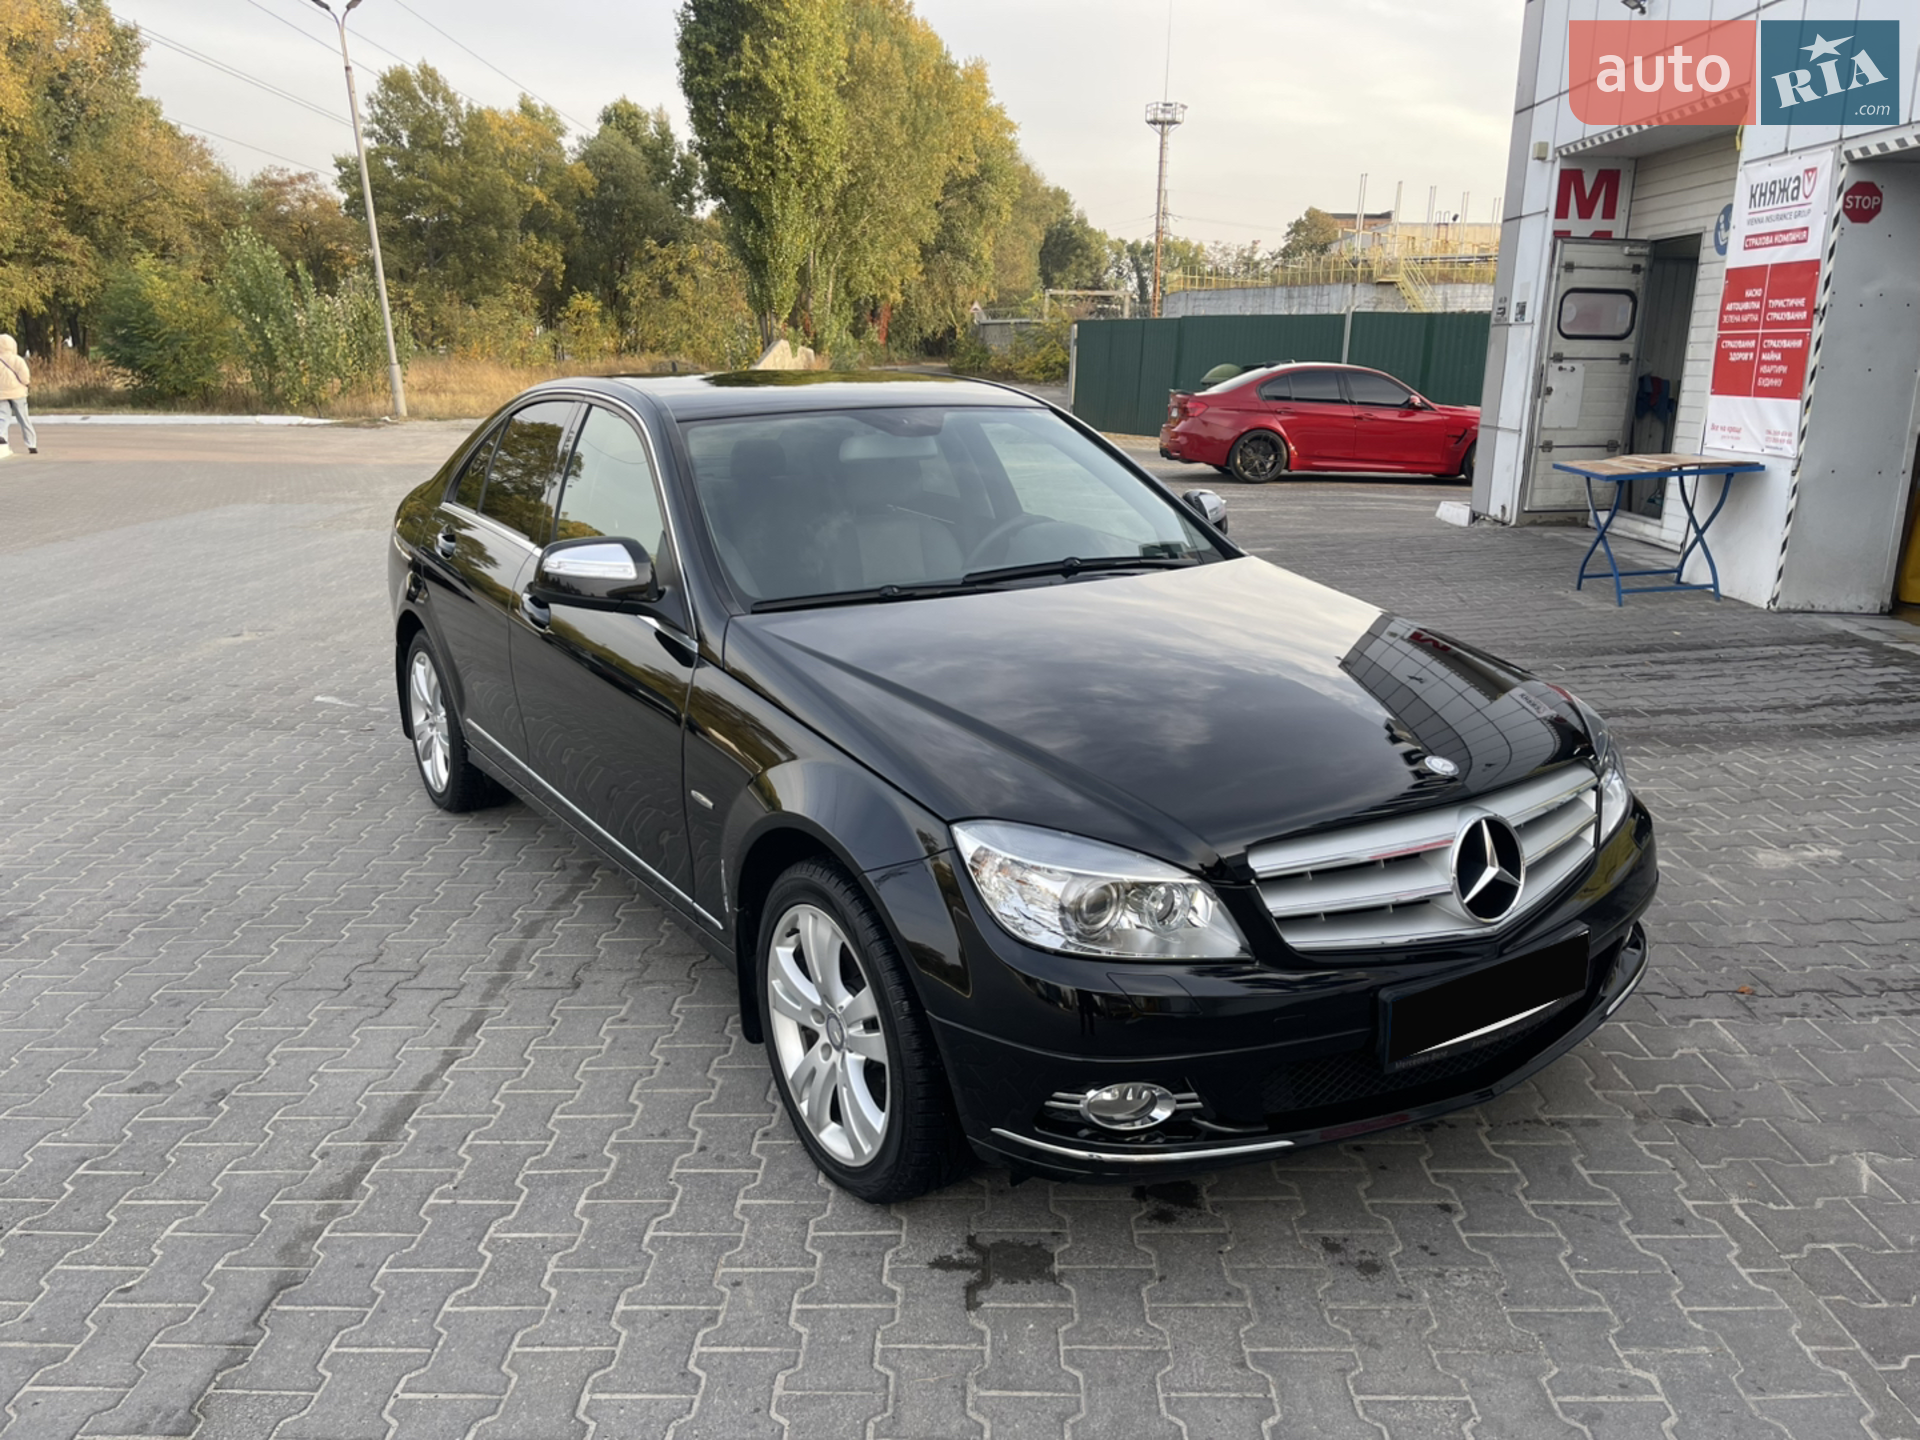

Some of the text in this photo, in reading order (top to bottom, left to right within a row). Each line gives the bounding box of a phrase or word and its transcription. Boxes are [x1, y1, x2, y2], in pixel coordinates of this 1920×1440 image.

[1845, 195, 1881, 209] STOP
[1747, 208, 1811, 226] VIENNA INSURANCE GROUP
[1745, 230, 1807, 248] СТРАХОВА КОМПАНІЯ
[1768, 297, 1806, 308] ТУРИСТИЧНЕ
[1766, 311, 1807, 321] СТРАХУВАННЯ
[1721, 339, 1755, 349] СТРАХУВАННЯ
[1763, 339, 1803, 348] СТРАХУВАННЯ
